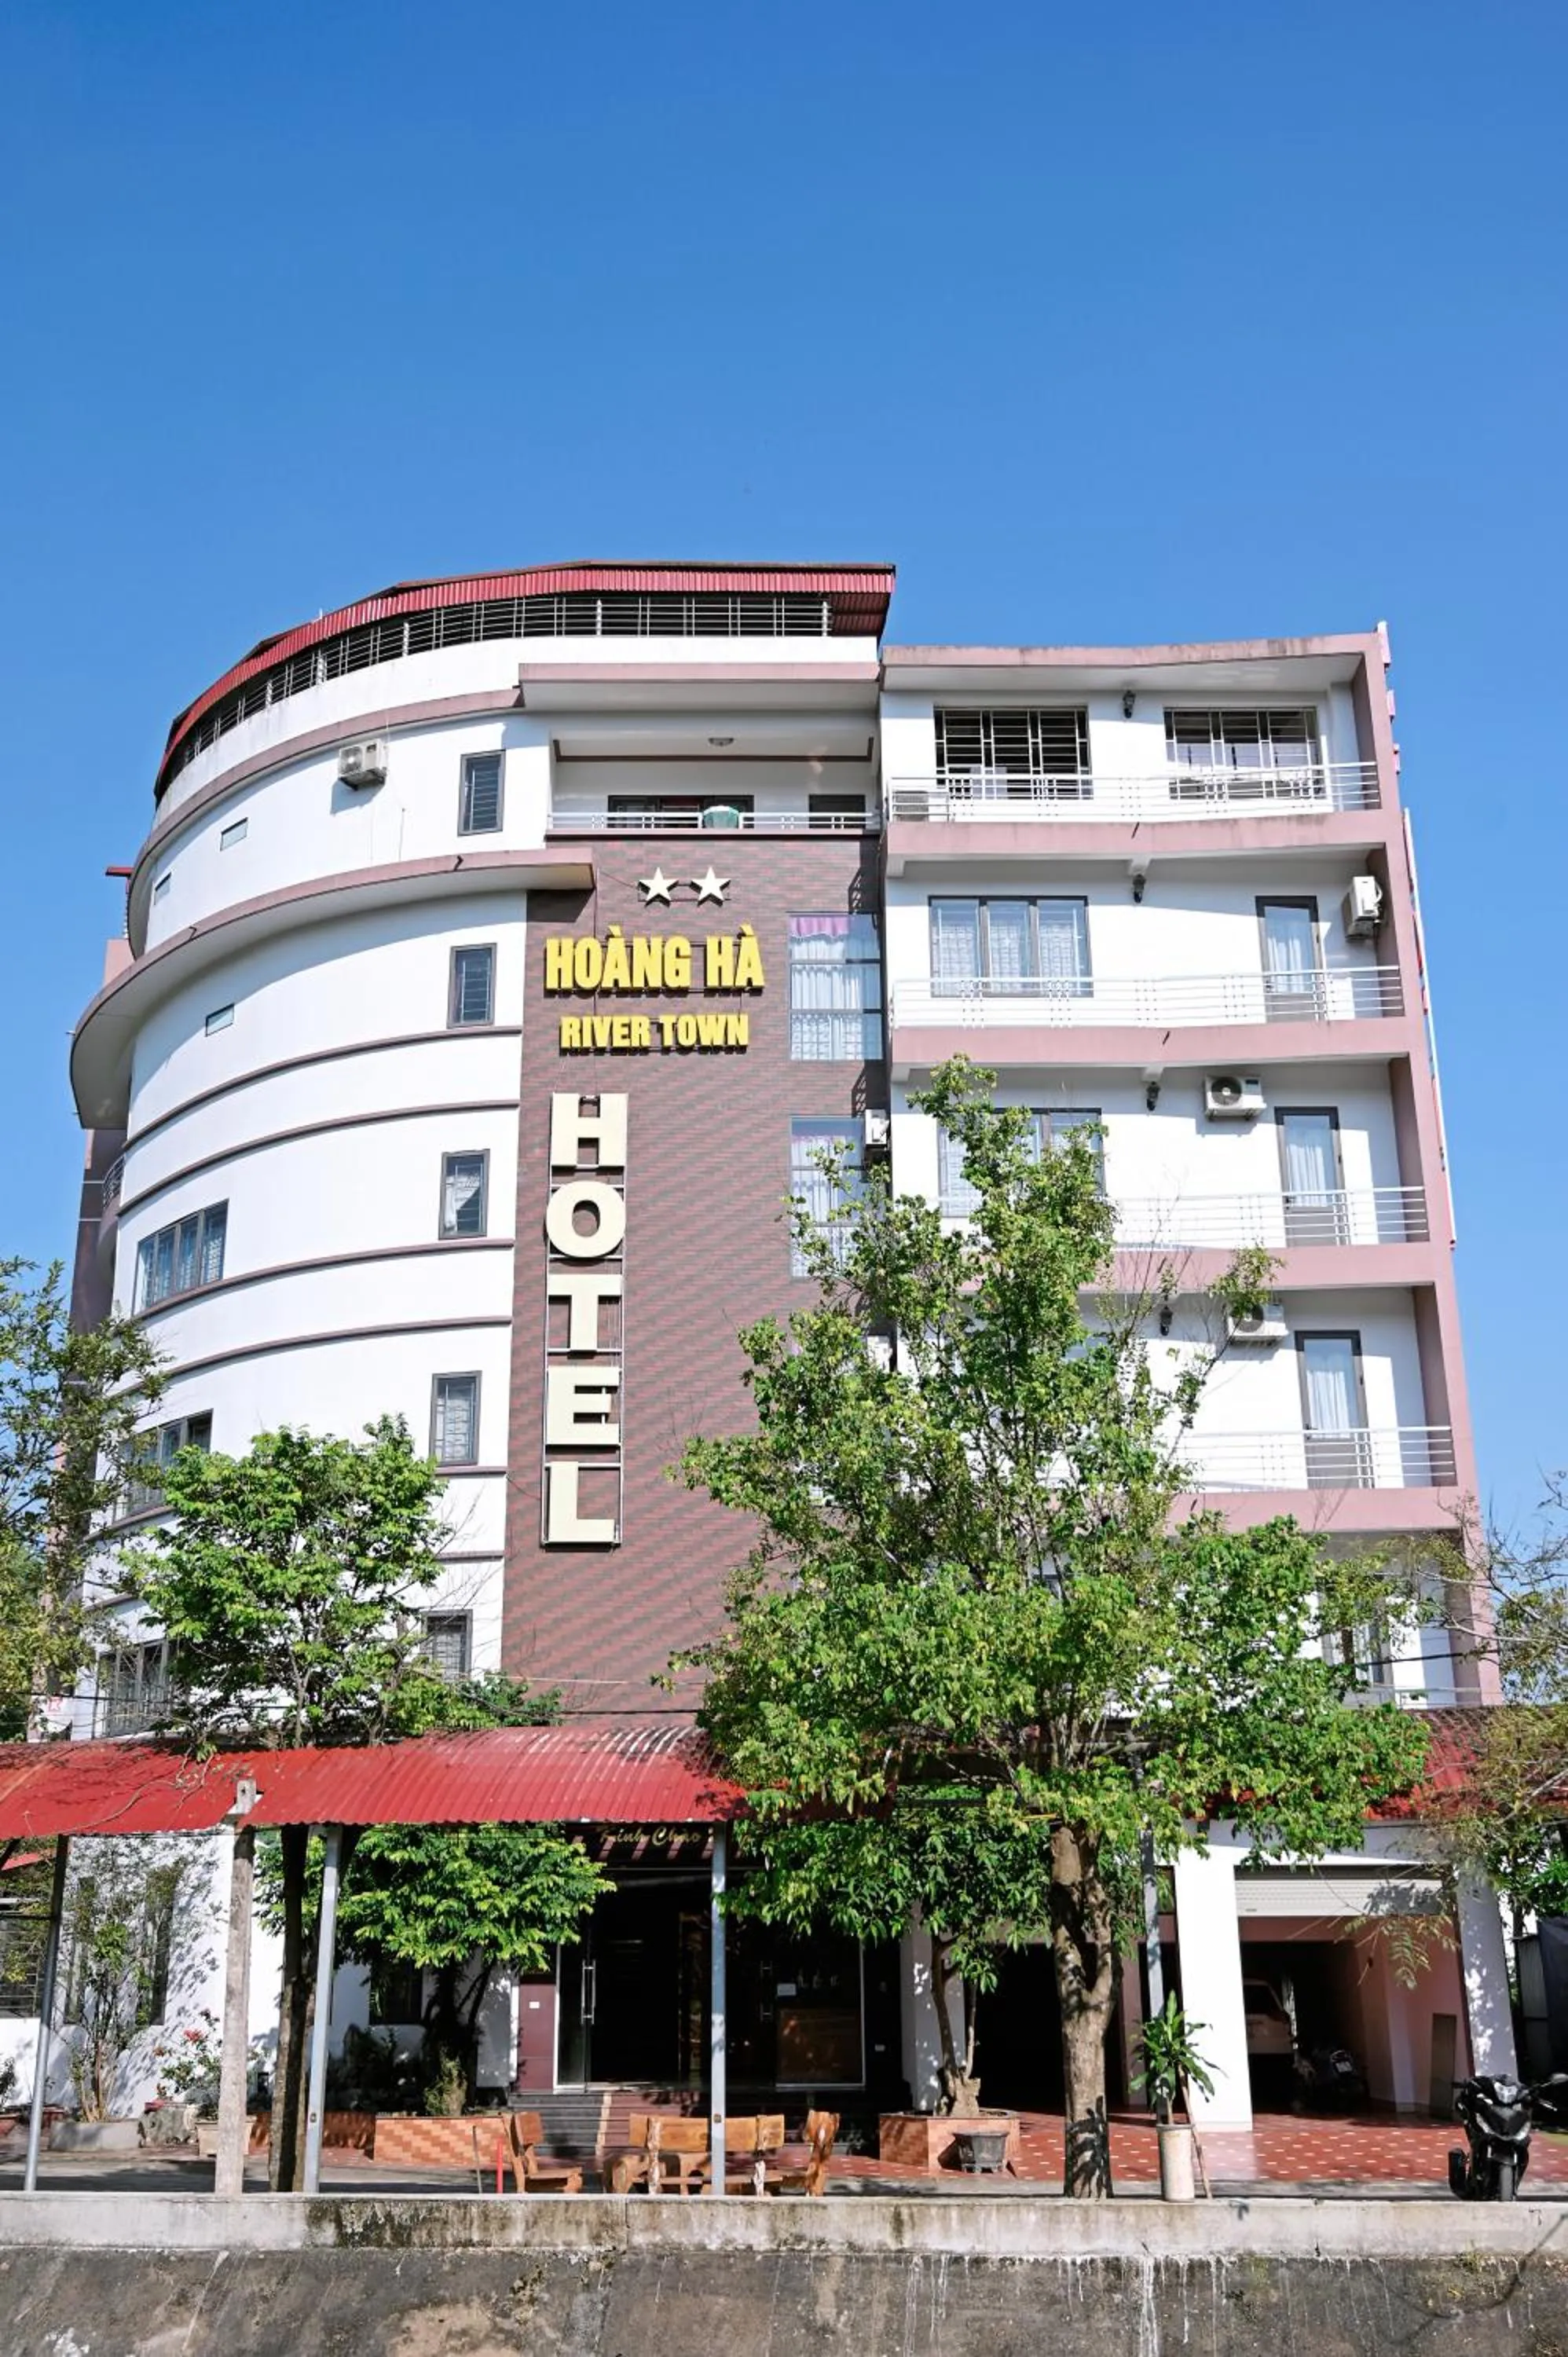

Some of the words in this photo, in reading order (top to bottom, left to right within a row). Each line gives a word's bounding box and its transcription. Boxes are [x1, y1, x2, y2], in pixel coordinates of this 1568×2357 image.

[544, 924, 692, 992] HOÀNG
[705, 923, 765, 991] HÀ
[560, 1015, 651, 1050] RIVER
[659, 1014, 749, 1048] TOWN
[545, 1092, 628, 1544] HOTEL
